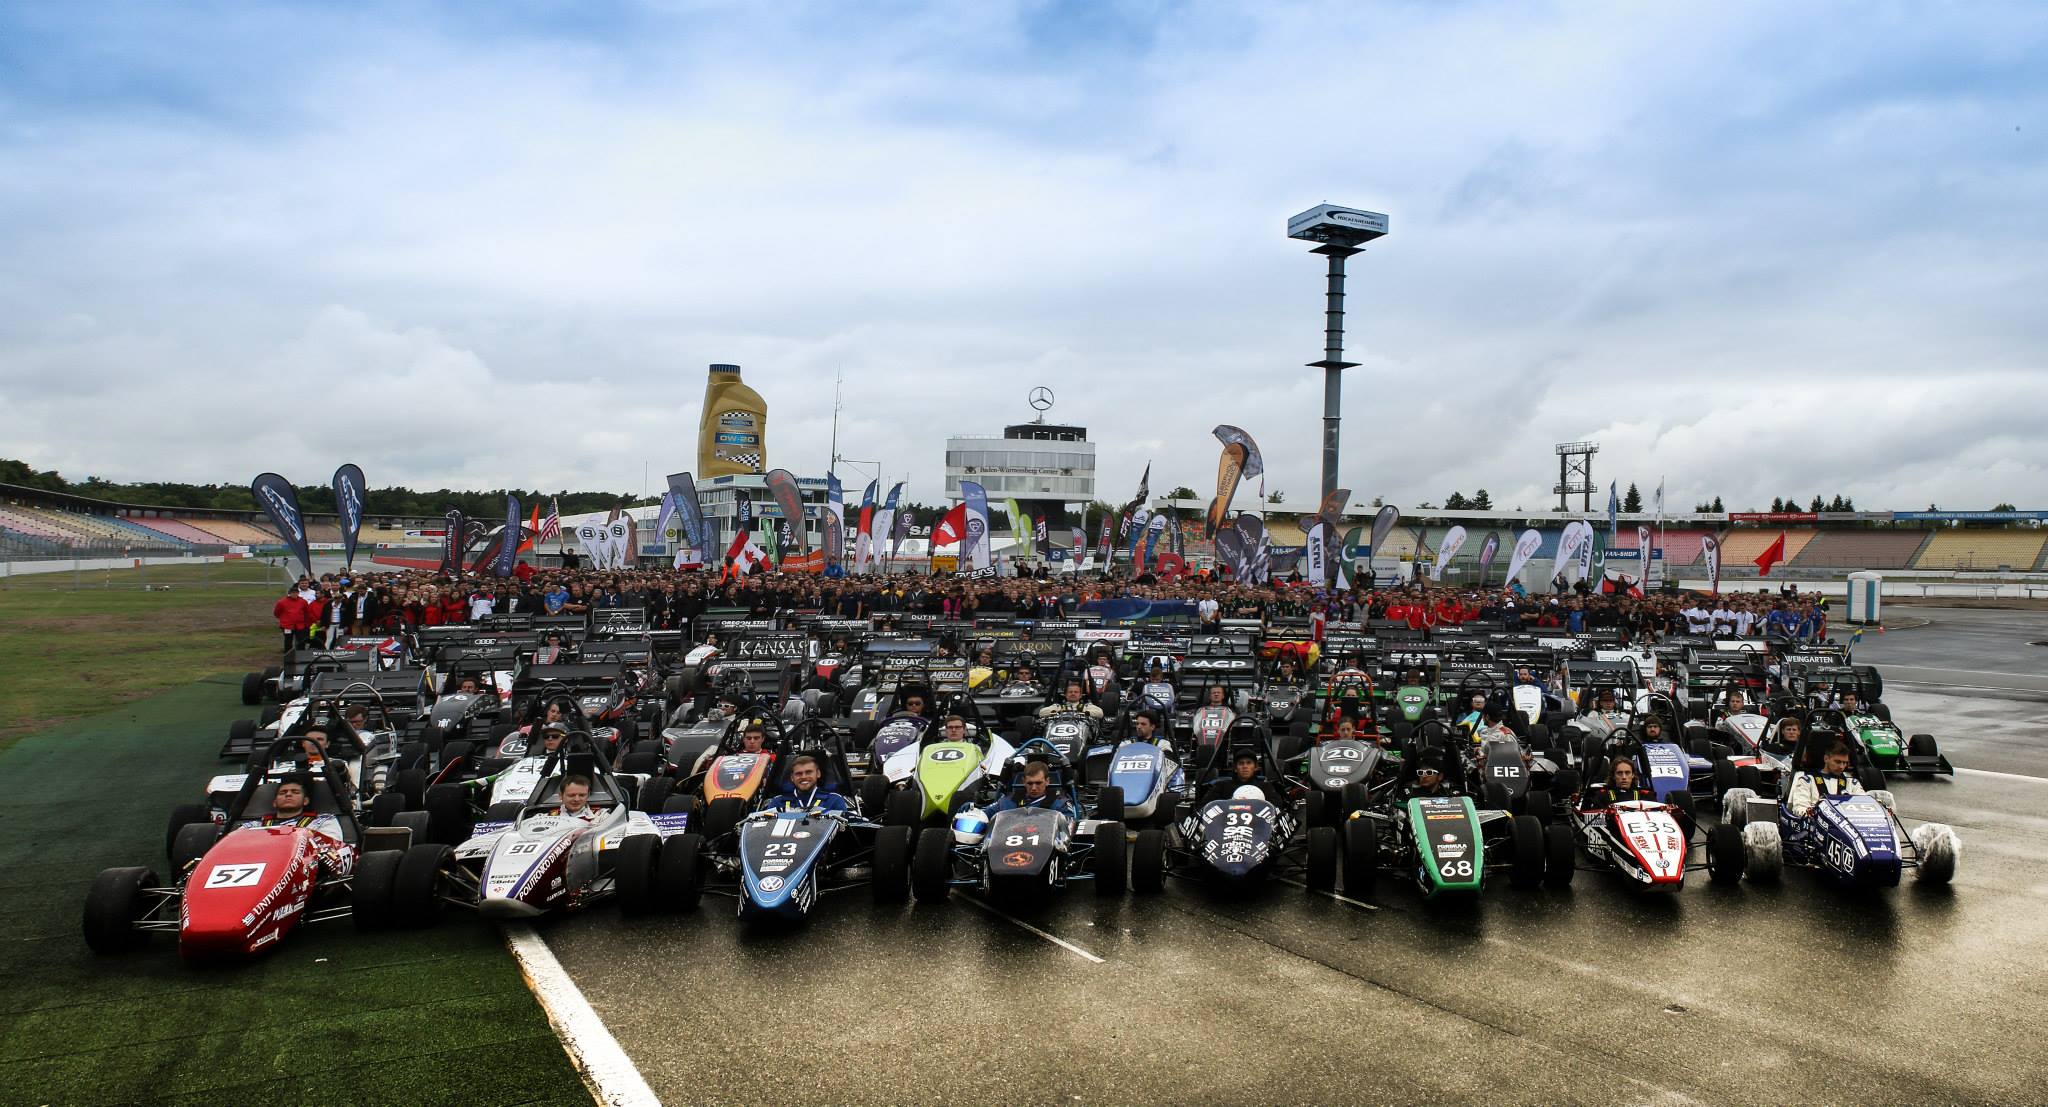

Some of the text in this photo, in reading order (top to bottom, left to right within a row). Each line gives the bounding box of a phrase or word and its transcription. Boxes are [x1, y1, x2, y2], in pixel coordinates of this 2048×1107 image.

[739, 640, 805, 655] KANSAS
[1010, 642, 1053, 651] AKRON
[936, 751, 957, 760] 14
[1326, 749, 1359, 760] 20
[1493, 766, 1520, 778] E12
[1226, 812, 1253, 826] 39
[1627, 822, 1676, 834] E35
[1005, 835, 1040, 847] 81
[510, 844, 537, 855] 90
[765, 842, 798, 857] 23
[1828, 840, 1841, 867] 45
[1440, 861, 1473, 877] 68
[212, 868, 259, 885] 57
[519, 858, 552, 901] POLITECNICO
[252, 867, 294, 916] UNIVERSITY
